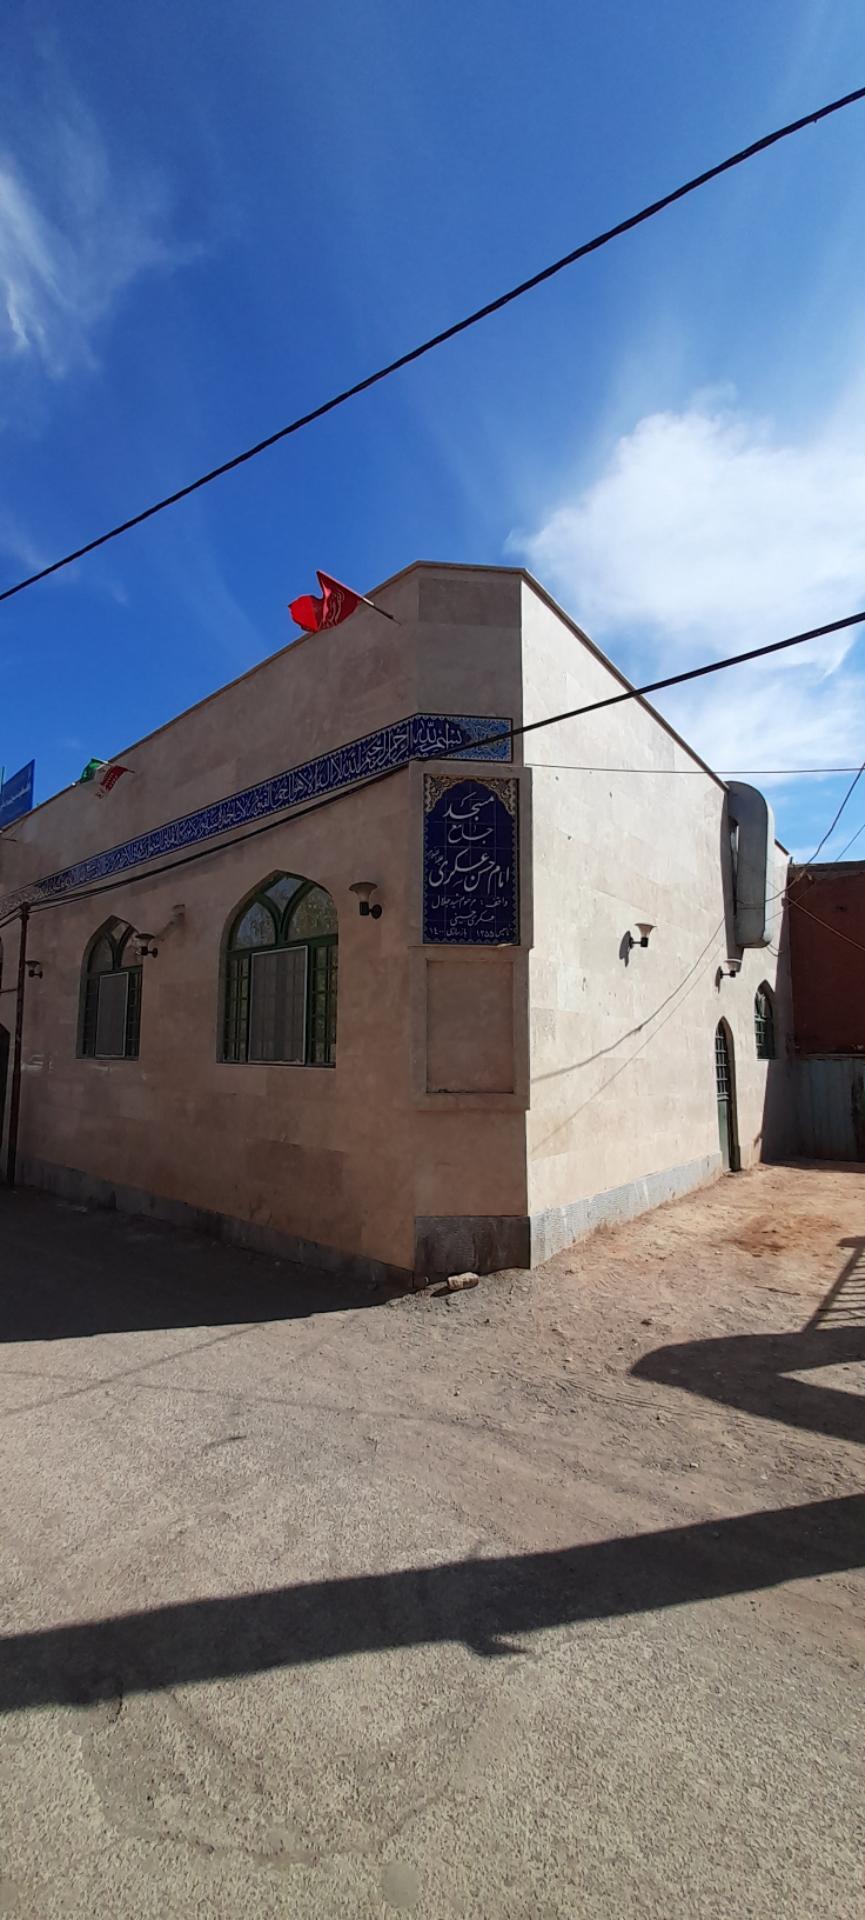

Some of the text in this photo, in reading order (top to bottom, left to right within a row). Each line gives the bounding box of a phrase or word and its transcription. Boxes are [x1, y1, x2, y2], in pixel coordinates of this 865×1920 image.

[442, 792, 494, 821] مسجد
[448, 824, 494, 845] جامع
[429, 848, 489, 888] عسکری
[463, 861, 495, 892] حسن
[487, 865, 509, 894] امام
